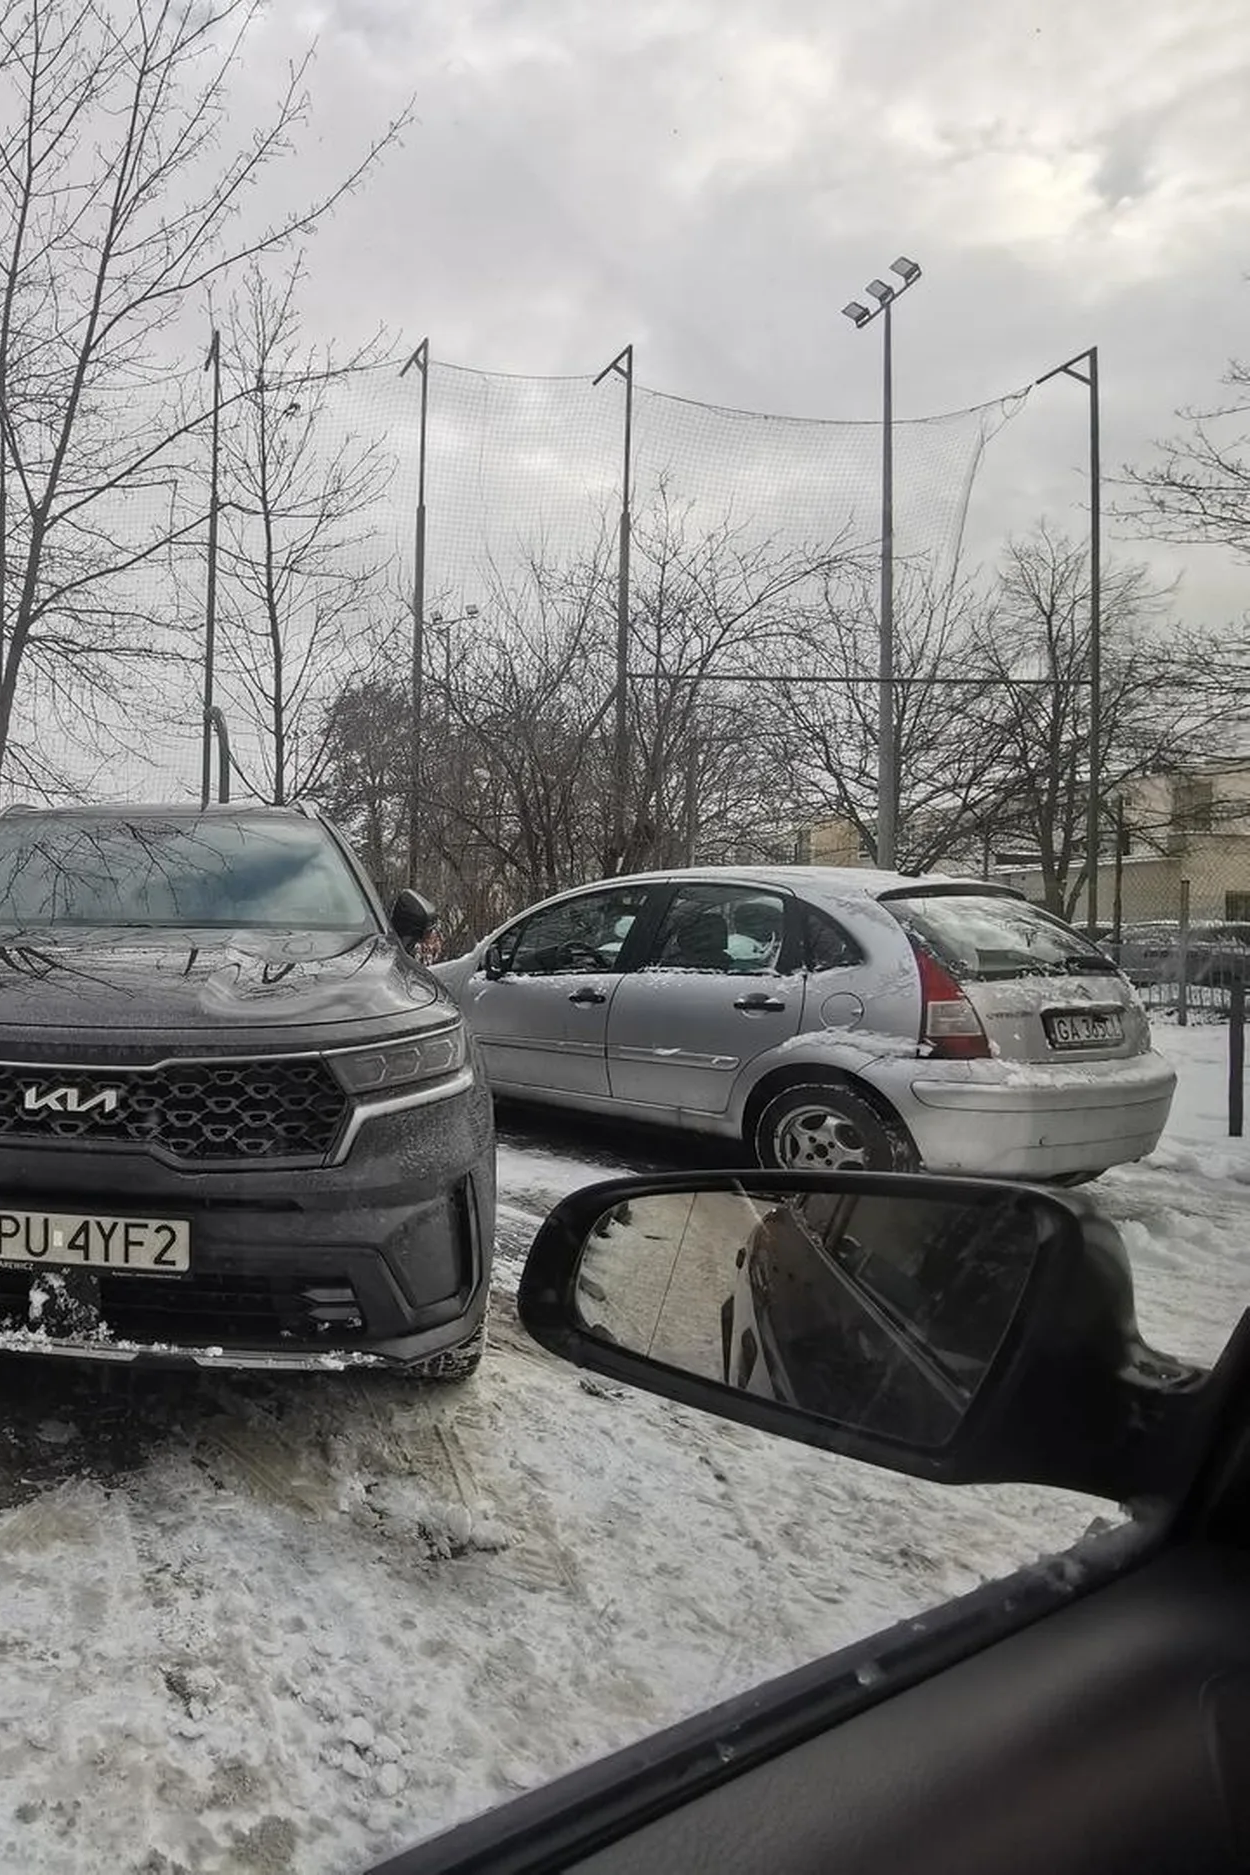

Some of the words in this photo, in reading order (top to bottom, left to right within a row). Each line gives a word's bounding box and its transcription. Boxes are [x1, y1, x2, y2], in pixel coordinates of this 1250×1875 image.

[1057, 1016, 1081, 1040] GA
[24, 1086, 117, 1113] KIA
[67, 1219, 178, 1267] 4YF2
